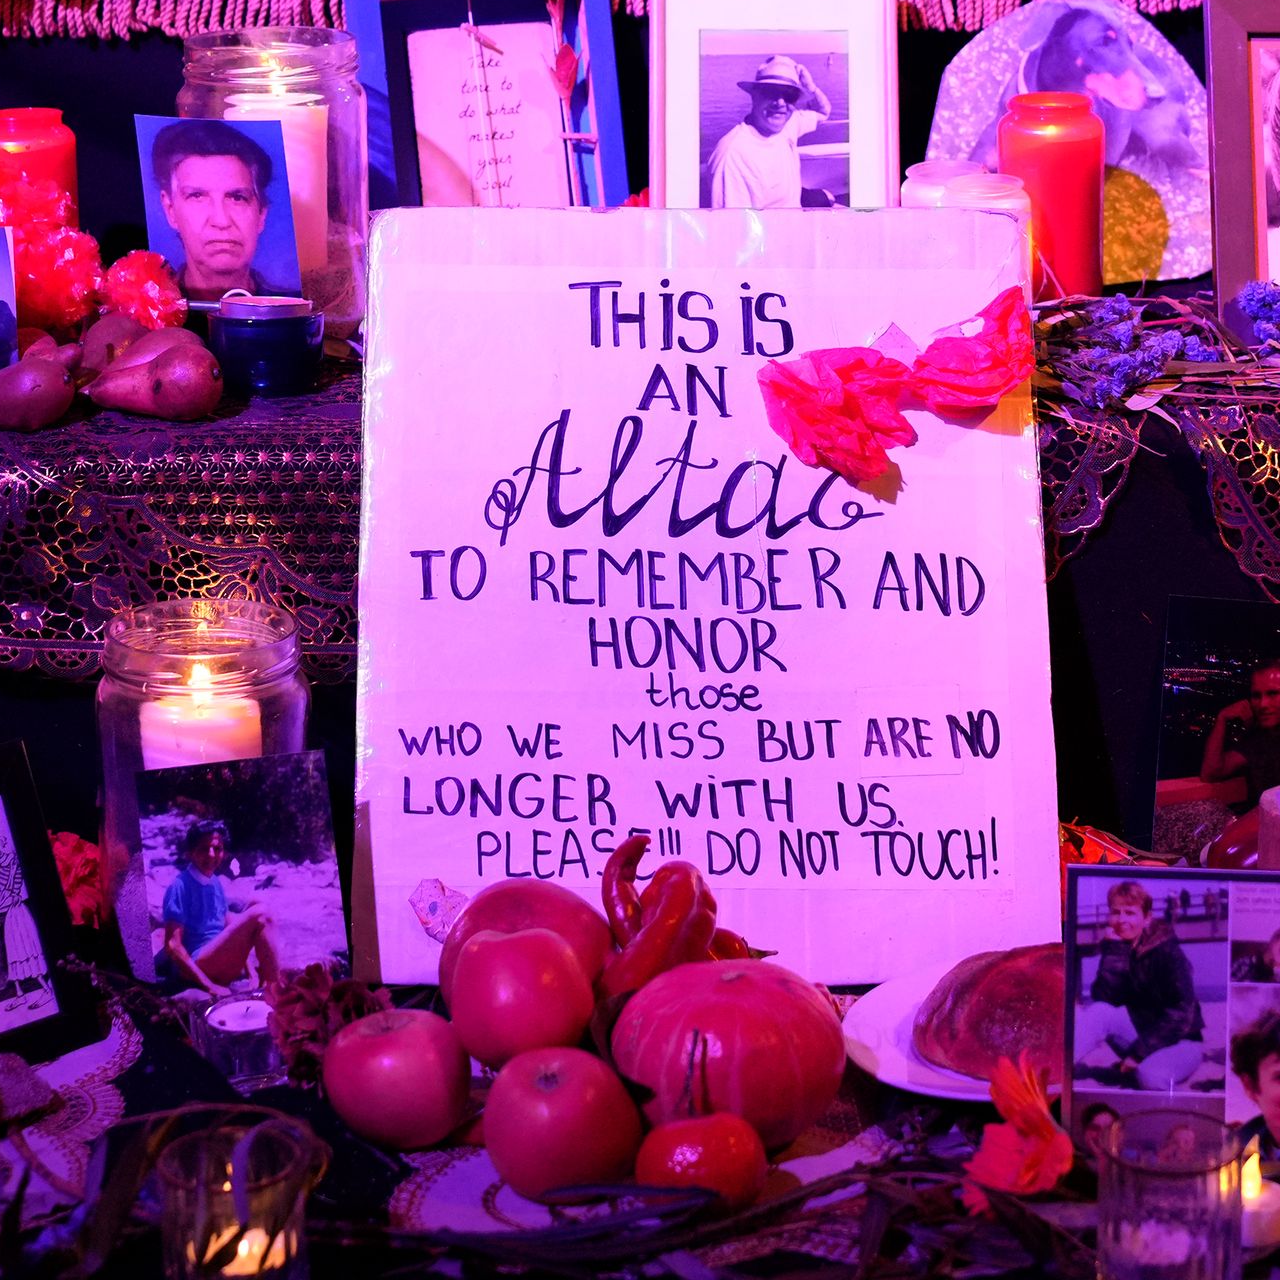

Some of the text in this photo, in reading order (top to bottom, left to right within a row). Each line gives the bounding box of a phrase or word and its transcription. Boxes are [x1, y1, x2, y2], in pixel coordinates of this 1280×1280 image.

[500, 75, 513, 91] to
[458, 104, 476, 119] do
[636, 363, 731, 419] AN
[410, 546, 985, 616] TO REMEMBER AND
[589, 617, 787, 672] HONOR
[646, 672, 762, 712] those
[398, 710, 1000, 762] WHO WE MISS BUT ARE NO
[404, 773, 616, 825] LONGER
[707, 828, 760, 875] DO
[779, 829, 839, 879] NOT
[861, 817, 999, 880] TOUCH!
